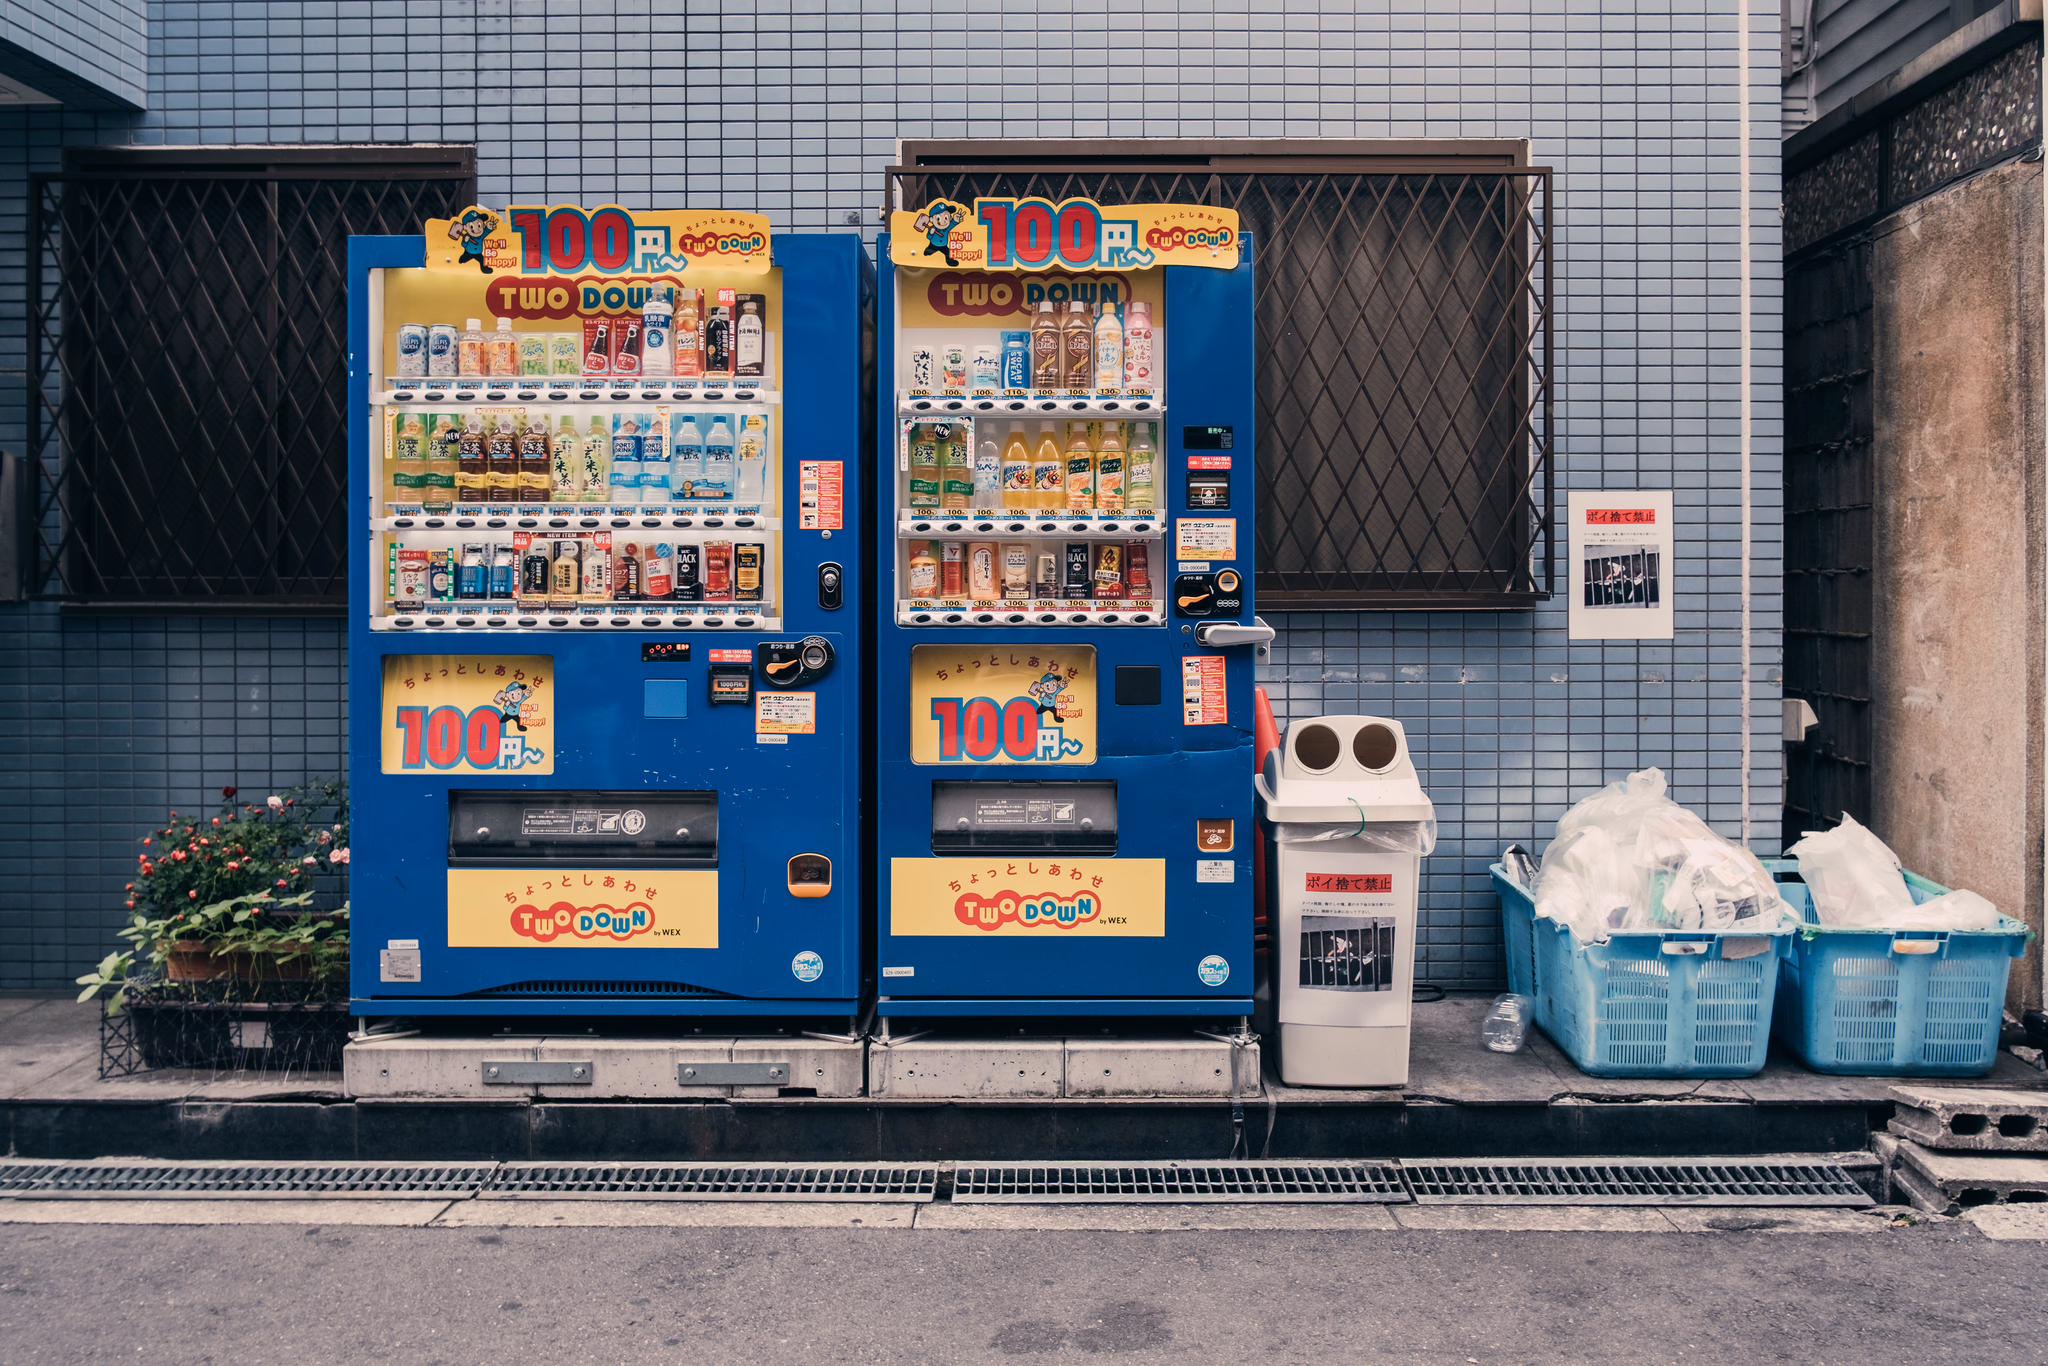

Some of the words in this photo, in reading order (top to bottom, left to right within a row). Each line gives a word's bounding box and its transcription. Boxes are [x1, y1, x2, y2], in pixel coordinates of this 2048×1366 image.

[686, 217, 755, 232] ちょっとしあわせ
[1154, 211, 1223, 226] ちょっとしあわせ
[484, 239, 506, 249] We'll
[685, 237, 716, 253] TWO
[720, 236, 761, 251] DOWN
[949, 232, 972, 242] We'll
[1151, 231, 1183, 248] TWO
[1188, 231, 1228, 246] DOWN
[484, 249, 497, 257] Be
[950, 242, 963, 250] Be
[484, 257, 517, 268] Happy!
[949, 250, 983, 261] Happy!
[499, 287, 570, 310] TWO
[941, 283, 1013, 306] TWO
[1027, 283, 1118, 305] DOWN
[445, 433, 460, 441] NEW
[935, 425, 951, 436] NEW
[398, 440, 417, 456] お茶
[430, 440, 449, 456] お茶
[914, 446, 934, 463] お茶
[554, 448, 571, 486] 玄米茶
[584, 447, 601, 486] 玄米茶
[1004, 465, 1025, 473] MIRACLE
[1035, 465, 1056, 473] MIRACLE
[1587, 511, 1655, 522] ポイ捨て禁止
[678, 554, 696, 563] BLACK
[1068, 553, 1087, 562] BLACK
[936, 654, 1078, 681] ちょっとしあわせ
[404, 663, 544, 689] ちょっとしあわせ
[1056, 709, 1082, 718] Happy!
[520, 718, 546, 727] Happy!
[948, 862, 1103, 892] ちょっとしあわせ
[1307, 876, 1391, 890] ポイ捨て禁止
[504, 874, 657, 904] ちょっとしあわせ
[964, 898, 1016, 924] TWO
[1026, 899, 1091, 922] DOWN
[520, 910, 571, 935] TWO
[580, 910, 645, 933] DOWN
